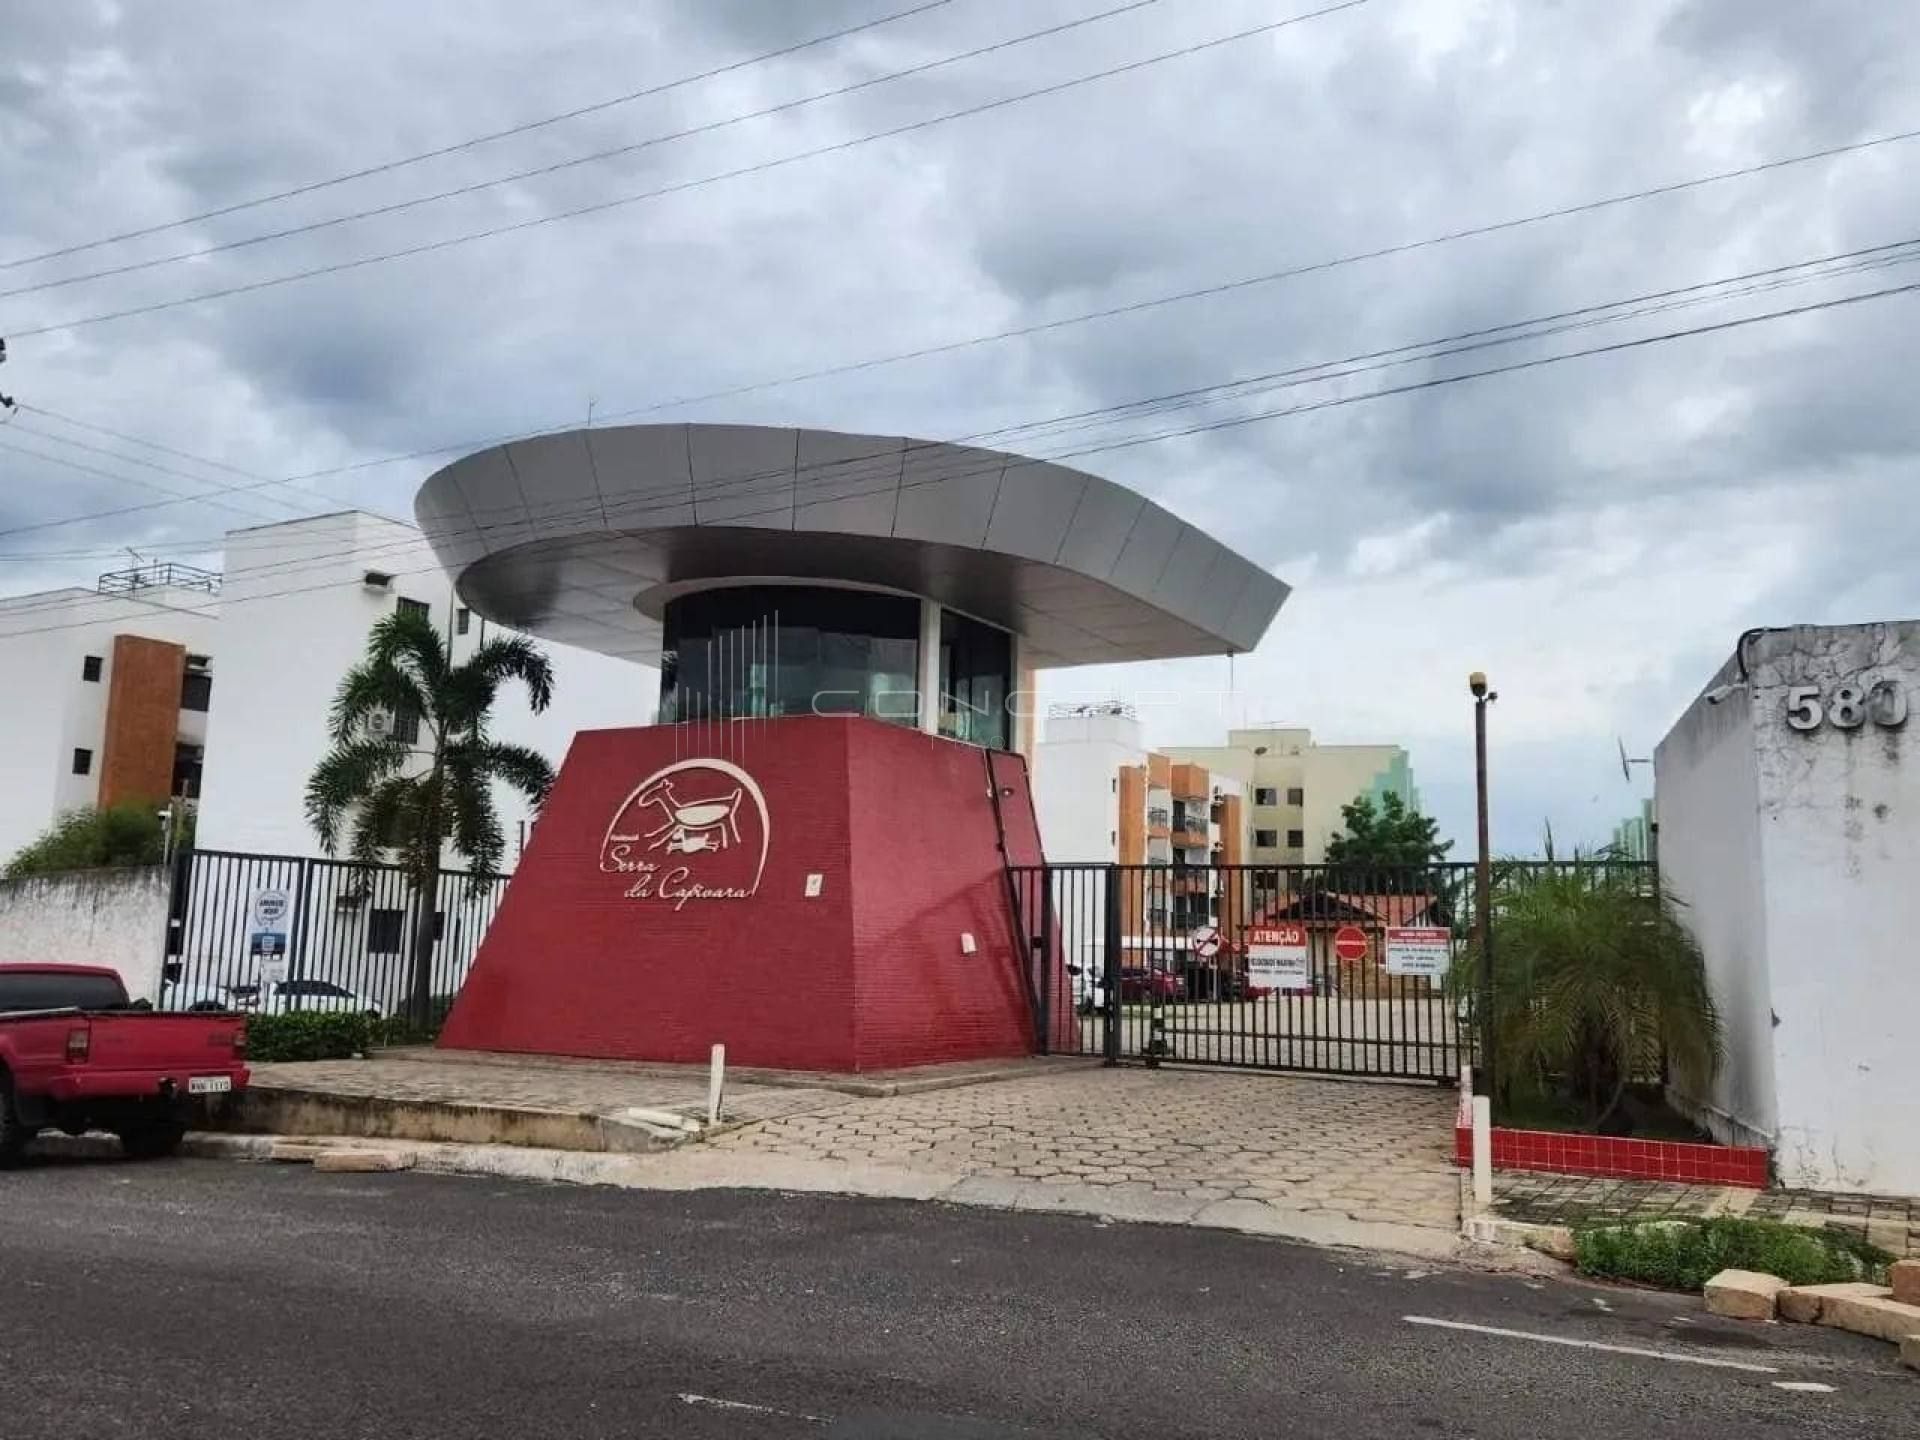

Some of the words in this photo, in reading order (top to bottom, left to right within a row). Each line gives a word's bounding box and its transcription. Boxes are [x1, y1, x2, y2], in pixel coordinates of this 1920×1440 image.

[1787, 679, 1907, 729] 580
[606, 844, 660, 872] Serra
[624, 873, 653, 898] da
[1253, 928, 1300, 945] ATENÇÃO
